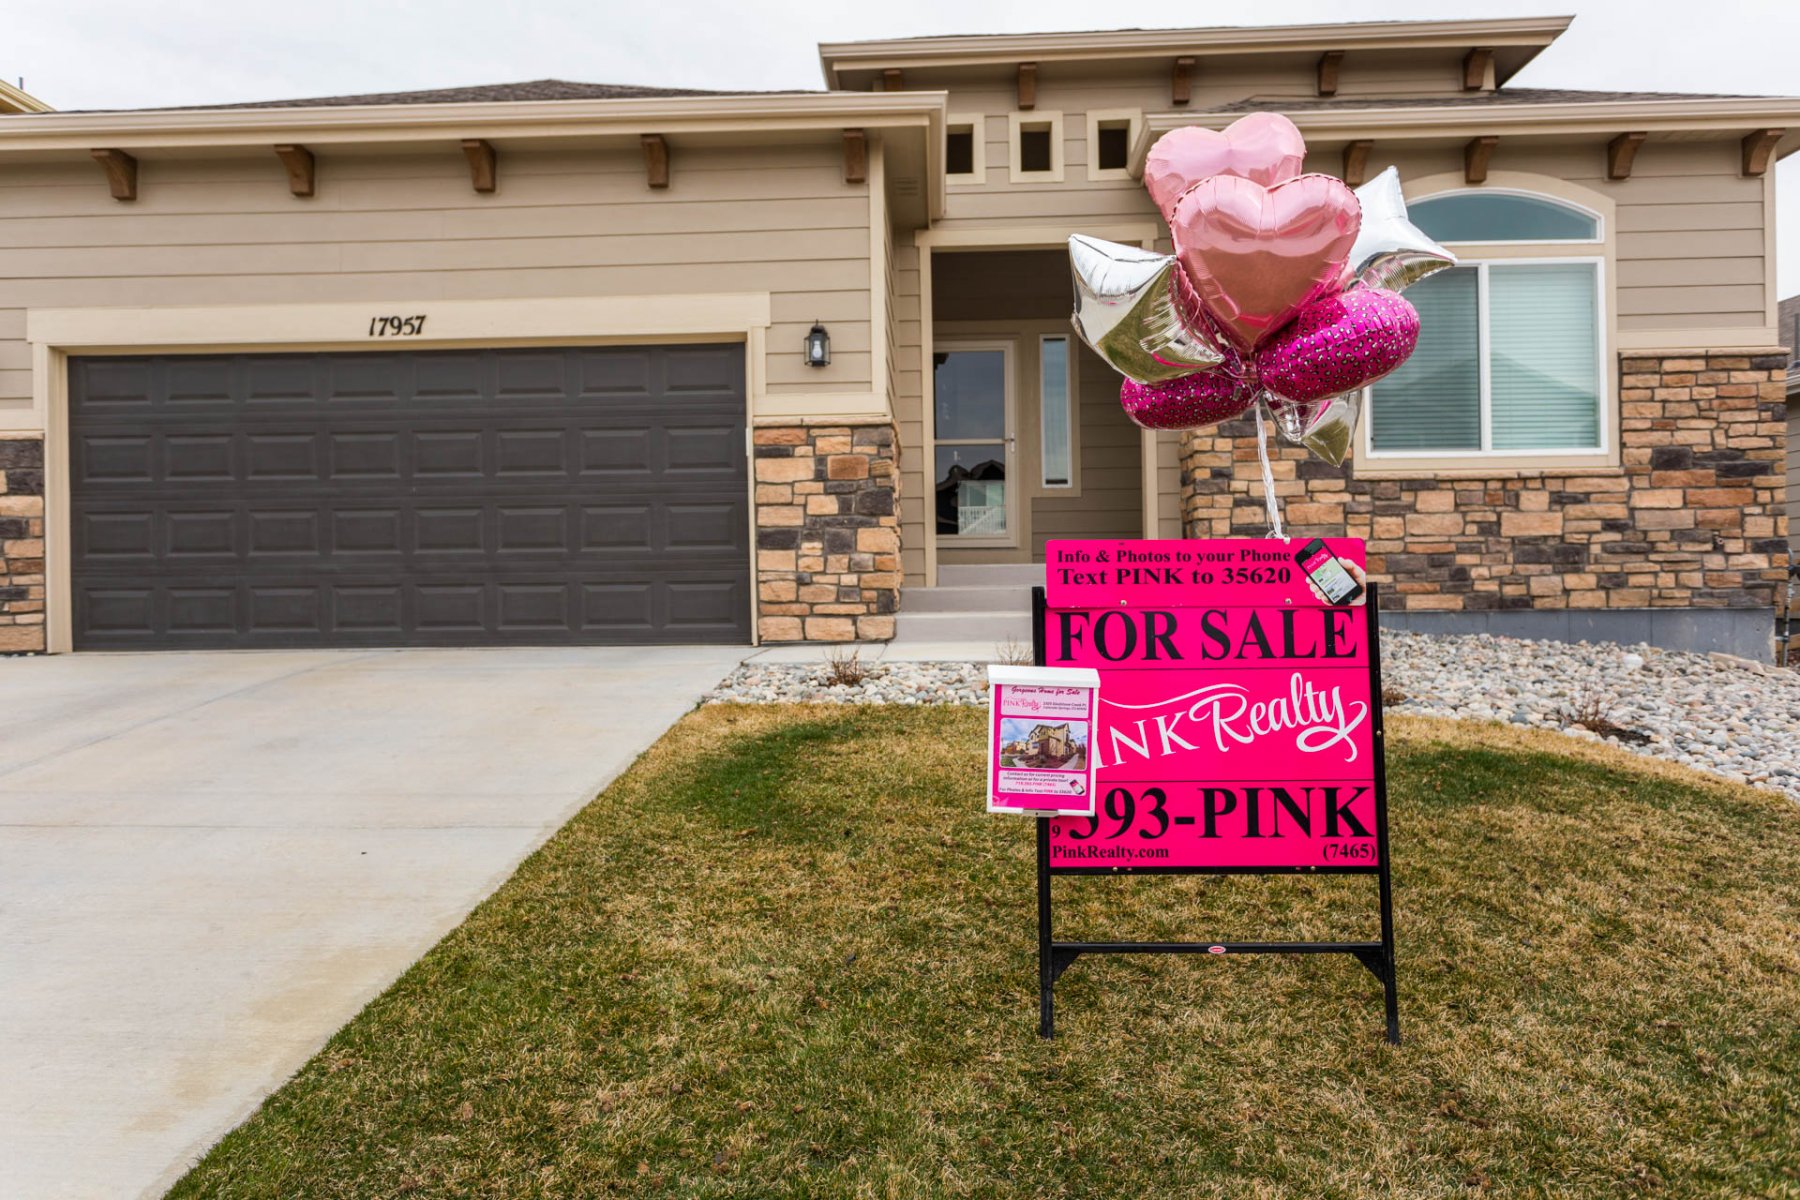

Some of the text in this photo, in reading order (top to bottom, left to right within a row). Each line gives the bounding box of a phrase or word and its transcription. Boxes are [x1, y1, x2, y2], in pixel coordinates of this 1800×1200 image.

[369, 314, 427, 337] 17957
[1057, 549, 1091, 563] Info
[1095, 550, 1110, 563] &
[1116, 549, 1171, 563] Photos
[1175, 551, 1192, 563] to
[1196, 552, 1235, 566] your
[1240, 549, 1291, 562] Phone
[1057, 566, 1291, 585] Text PINK to 35620
[1055, 608, 1357, 662] FOR SALE
[1188, 672, 1368, 762] Realty
[1052, 843, 1376, 862] PinkRealty.com (7465)
